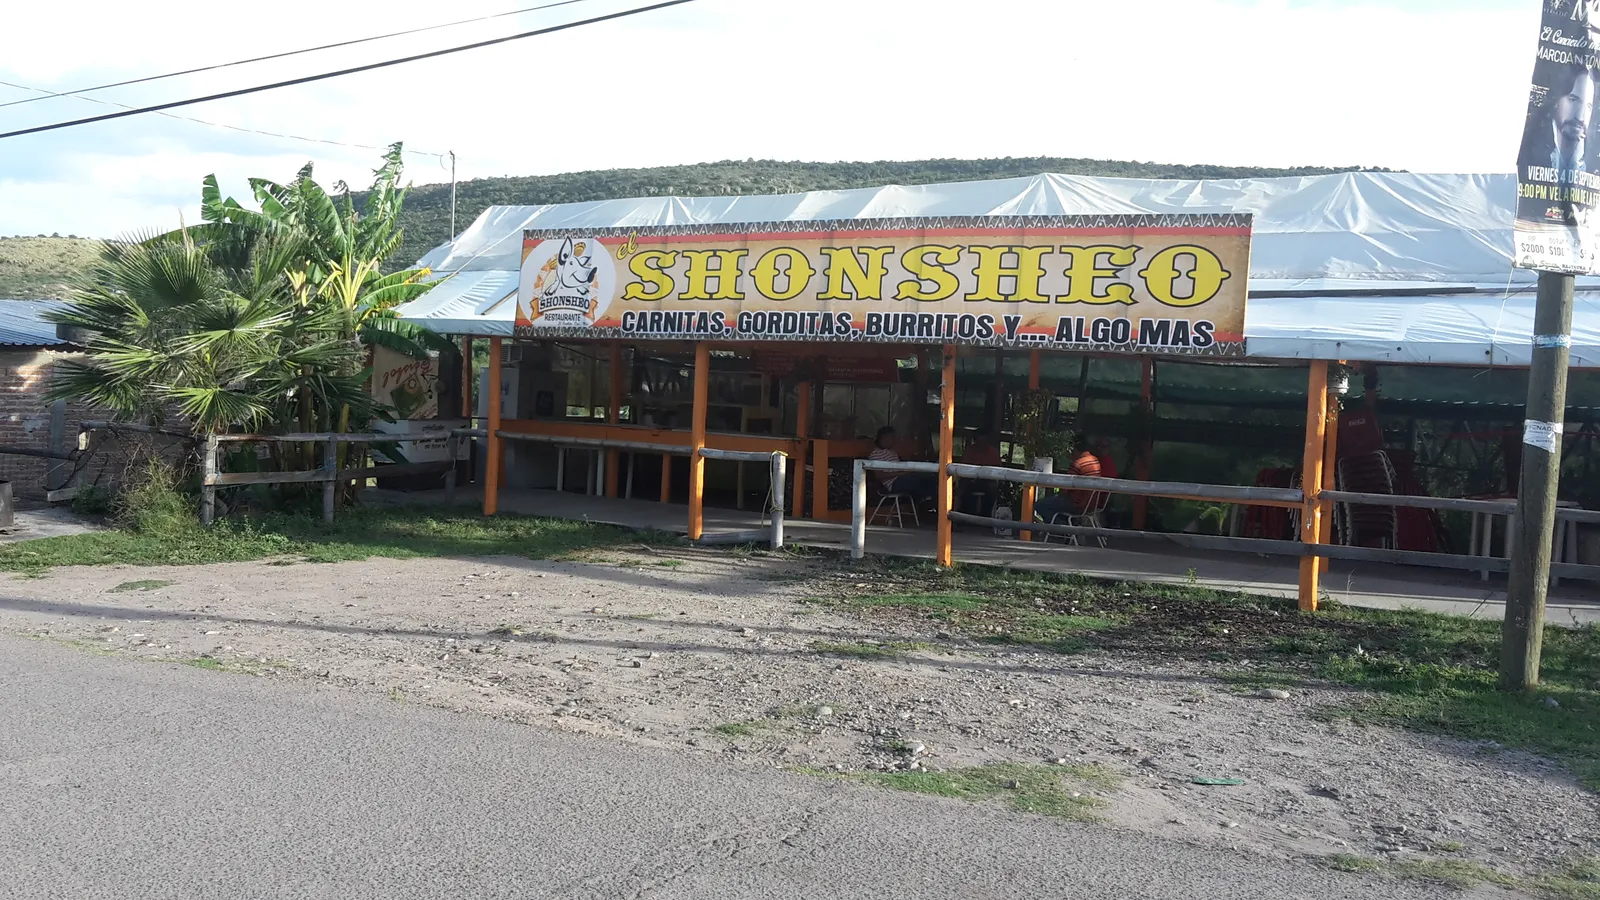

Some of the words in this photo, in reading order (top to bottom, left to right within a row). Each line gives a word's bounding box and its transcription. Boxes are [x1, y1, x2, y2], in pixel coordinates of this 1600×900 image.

[1541, 26, 1553, 41] El
[1552, 29, 1587, 48] Concierto
[1528, 165, 1558, 183] VIERNES
[1560, 169, 1566, 183] 4
[1568, 169, 1578, 184] DE
[1518, 183, 1534, 199] 9:00
[1535, 185, 1547, 200] PM
[617, 230, 639, 260] el
[1521, 242, 1545, 254] $2000
[621, 244, 1232, 307] SHONSHEO
[540, 296, 590, 310] SHONSHEO
[544, 313, 581, 322] RESTAURANTE
[621, 310, 731, 337] CARNITAS,
[737, 311, 859, 338] GORDITAS,
[865, 312, 995, 340] BURRITOS
[1054, 315, 1130, 344] ALGO
[1138, 317, 1215, 348] MAS
